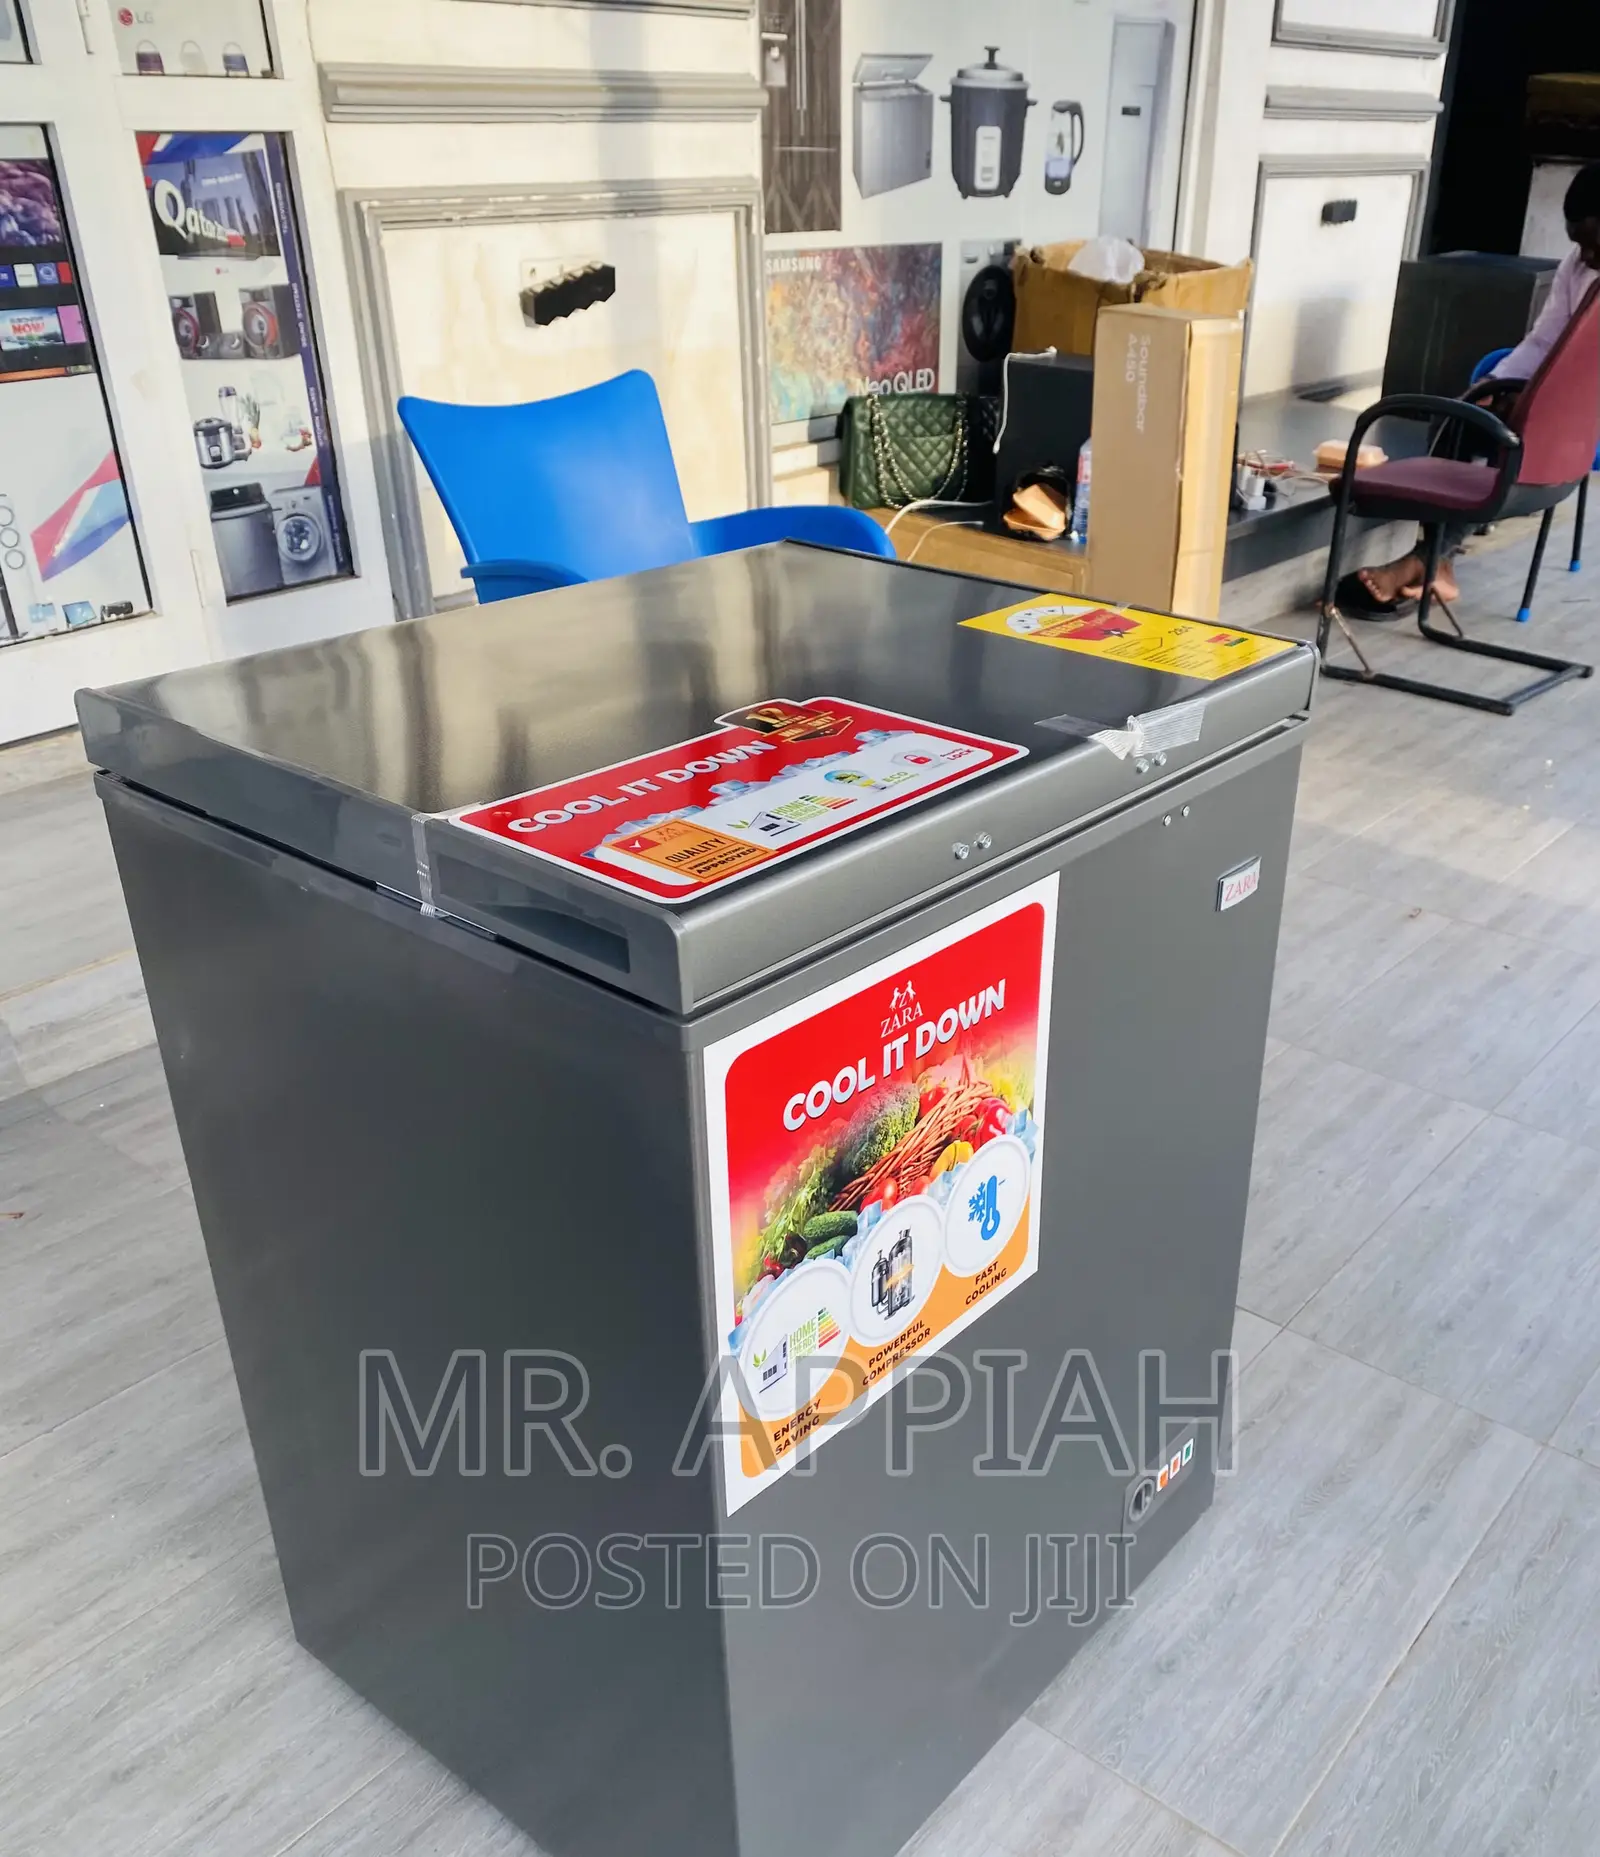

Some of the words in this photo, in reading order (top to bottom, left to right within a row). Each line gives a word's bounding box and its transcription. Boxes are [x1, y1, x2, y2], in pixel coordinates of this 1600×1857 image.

[765, 255, 822, 274] SAMSUNG
[856, 375, 892, 396] Neo
[893, 367, 936, 393] QLED
[1136, 334, 1151, 434] Soundbar
[745, 707, 787, 724] 12
[778, 716, 836, 738] WARANTY
[947, 749, 974, 761] LOCK
[507, 794, 630, 833] COOL
[618, 777, 662, 797] IT
[655, 740, 777, 783] DOWN
[664, 838, 727, 864] QUALITY
[687, 856, 718, 871] ENERGY
[695, 847, 758, 875] APPROVED
[1223, 871, 1258, 903] ZARA
[880, 1001, 923, 1038] ZARA
[783, 1057, 876, 1132] COOL
[882, 1034, 909, 1078] IT
[915, 978, 1006, 1059] DOWN
[965, 1268, 1007, 1305] COOLING
[975, 1261, 998, 1285] FAST
[789, 1317, 817, 1349] HOME
[868, 1320, 925, 1369] POWERFUL
[862, 1327, 931, 1386] COMPRESSOR
[773, 1398, 821, 1442] ENERGY
[775, 1415, 820, 1456] SAVING
